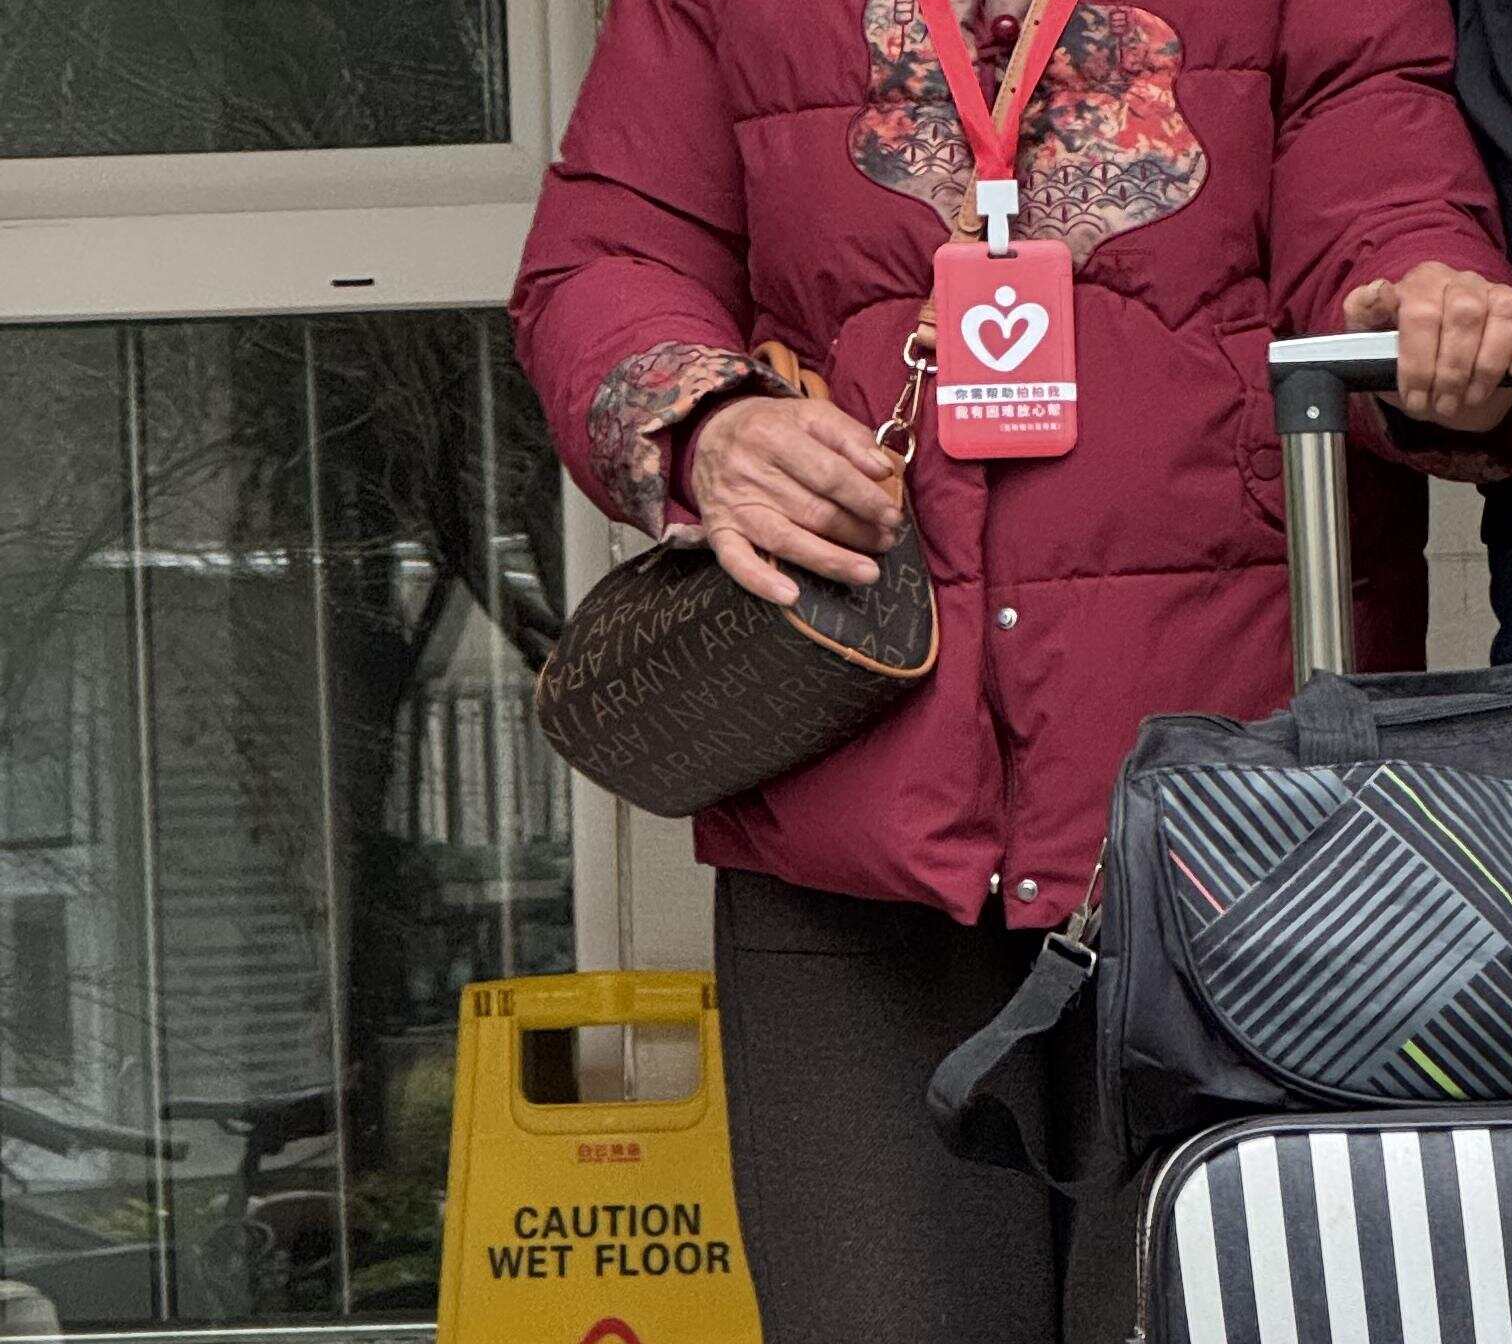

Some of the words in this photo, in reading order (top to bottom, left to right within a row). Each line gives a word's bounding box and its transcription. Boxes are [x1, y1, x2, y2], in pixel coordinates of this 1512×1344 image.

[515, 1202, 702, 1240] CAUTION
[487, 1245, 573, 1280] WET
[595, 1242, 732, 1278] FLOOR
